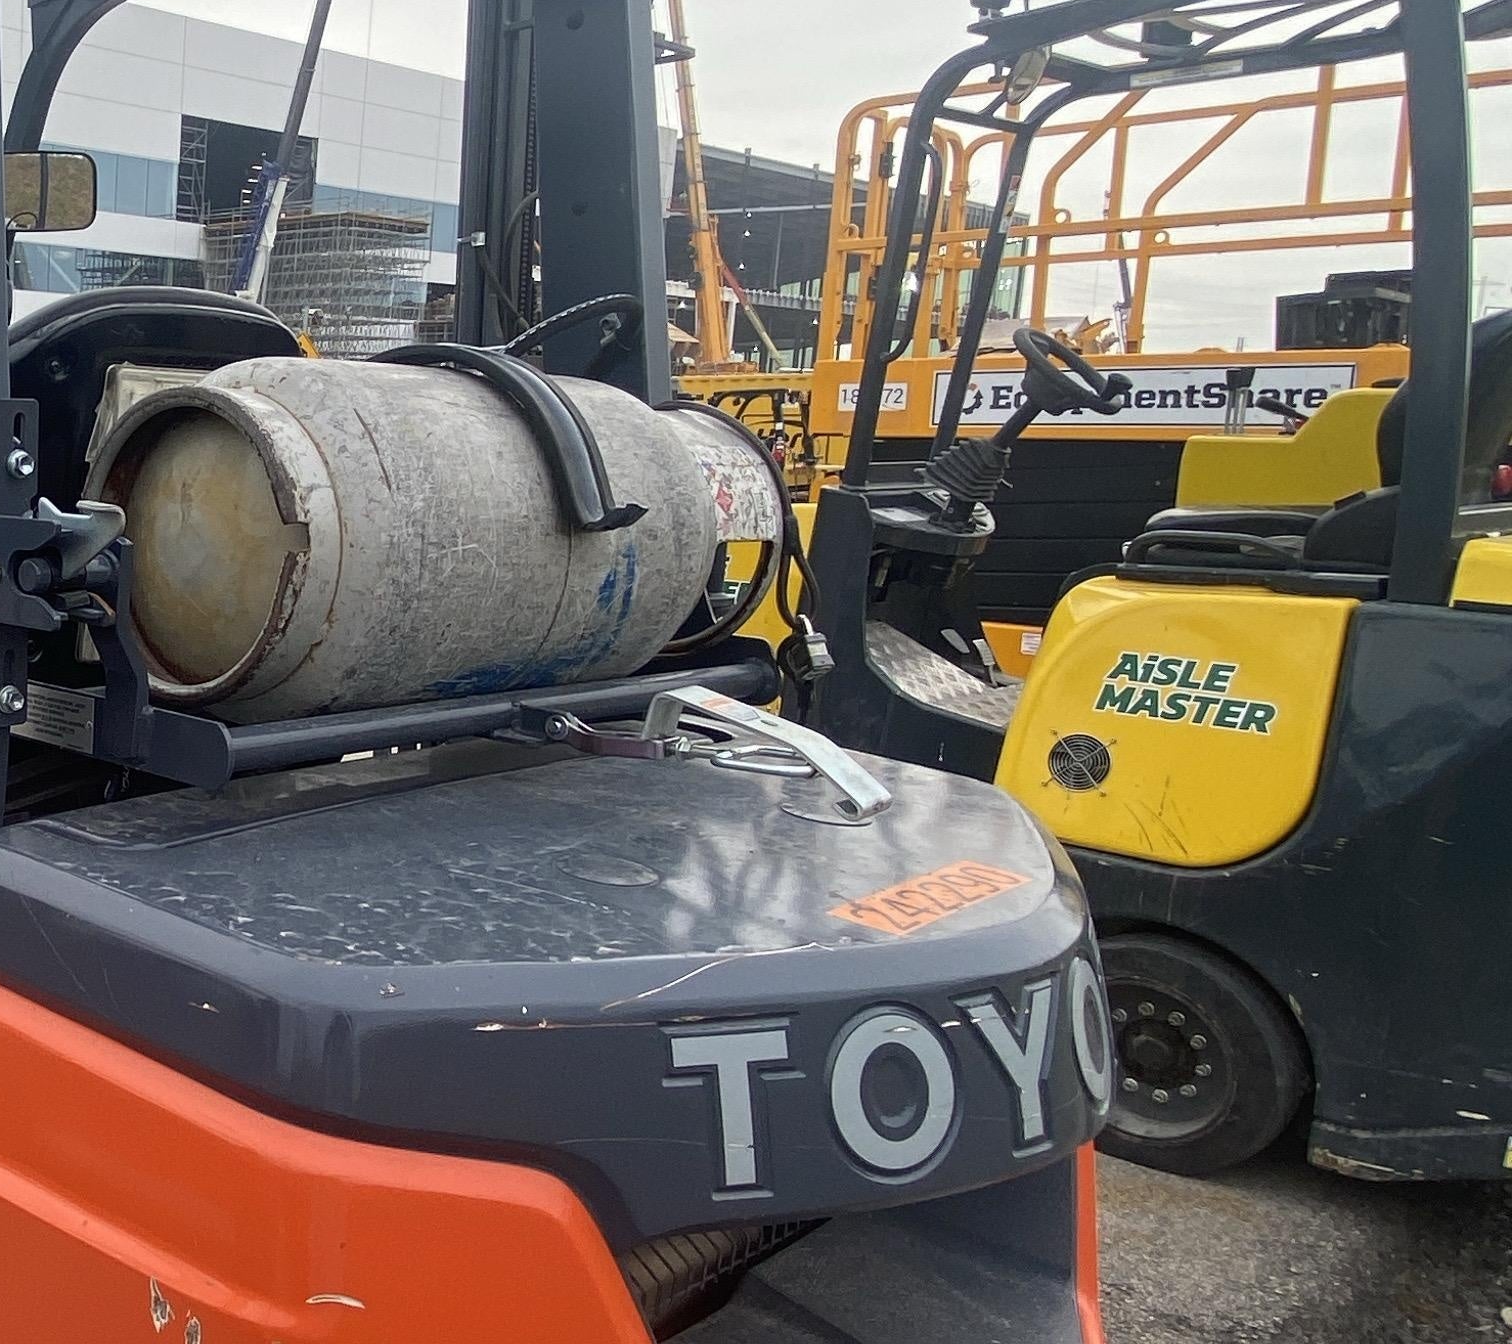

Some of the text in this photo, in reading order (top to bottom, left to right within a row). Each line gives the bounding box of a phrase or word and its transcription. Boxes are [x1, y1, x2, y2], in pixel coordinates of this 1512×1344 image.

[841, 387, 903, 405] 1872
[1094, 683, 1276, 733] MASTER
[849, 866, 1021, 931] 242290
